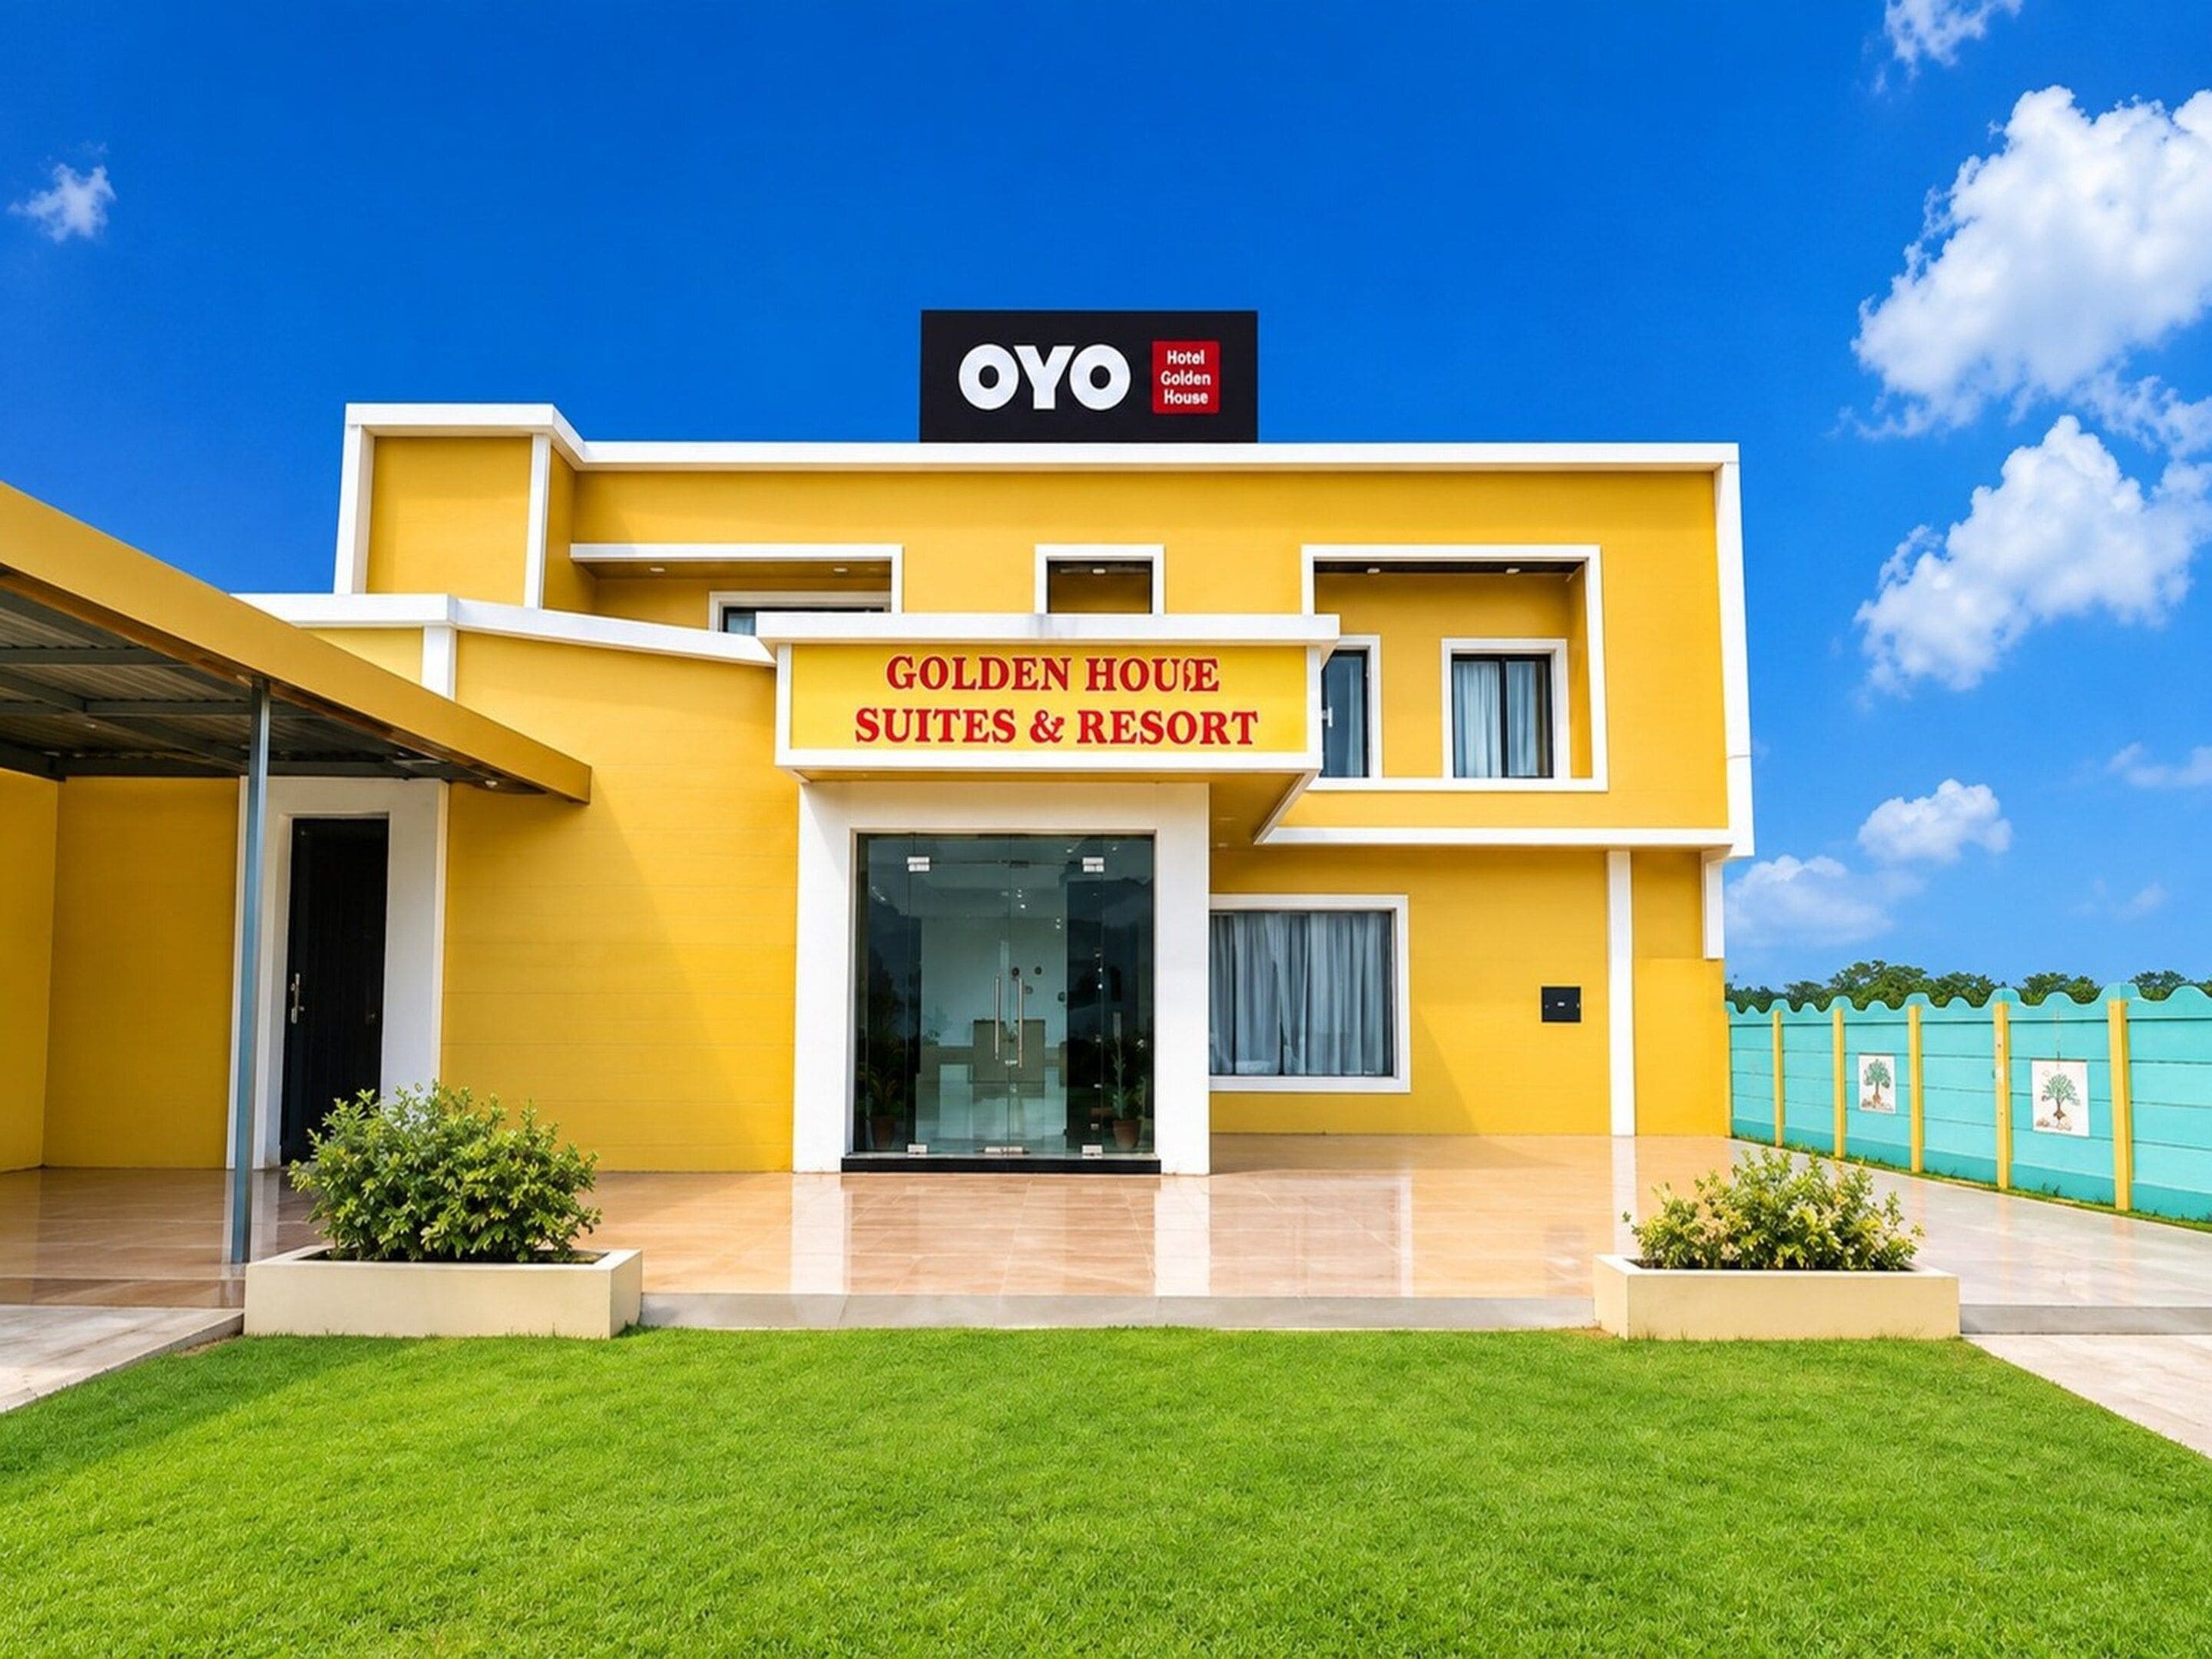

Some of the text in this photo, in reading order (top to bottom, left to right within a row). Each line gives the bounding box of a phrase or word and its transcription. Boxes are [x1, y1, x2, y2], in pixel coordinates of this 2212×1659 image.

[1167, 349, 1205, 365] Hotel
[958, 343, 1131, 411] OYO
[1161, 369, 1211, 386] Golden
[1164, 389, 1208, 405] House
[886, 655, 1071, 691] GOLDEN
[855, 707, 1258, 745] SUITES & RESORT
